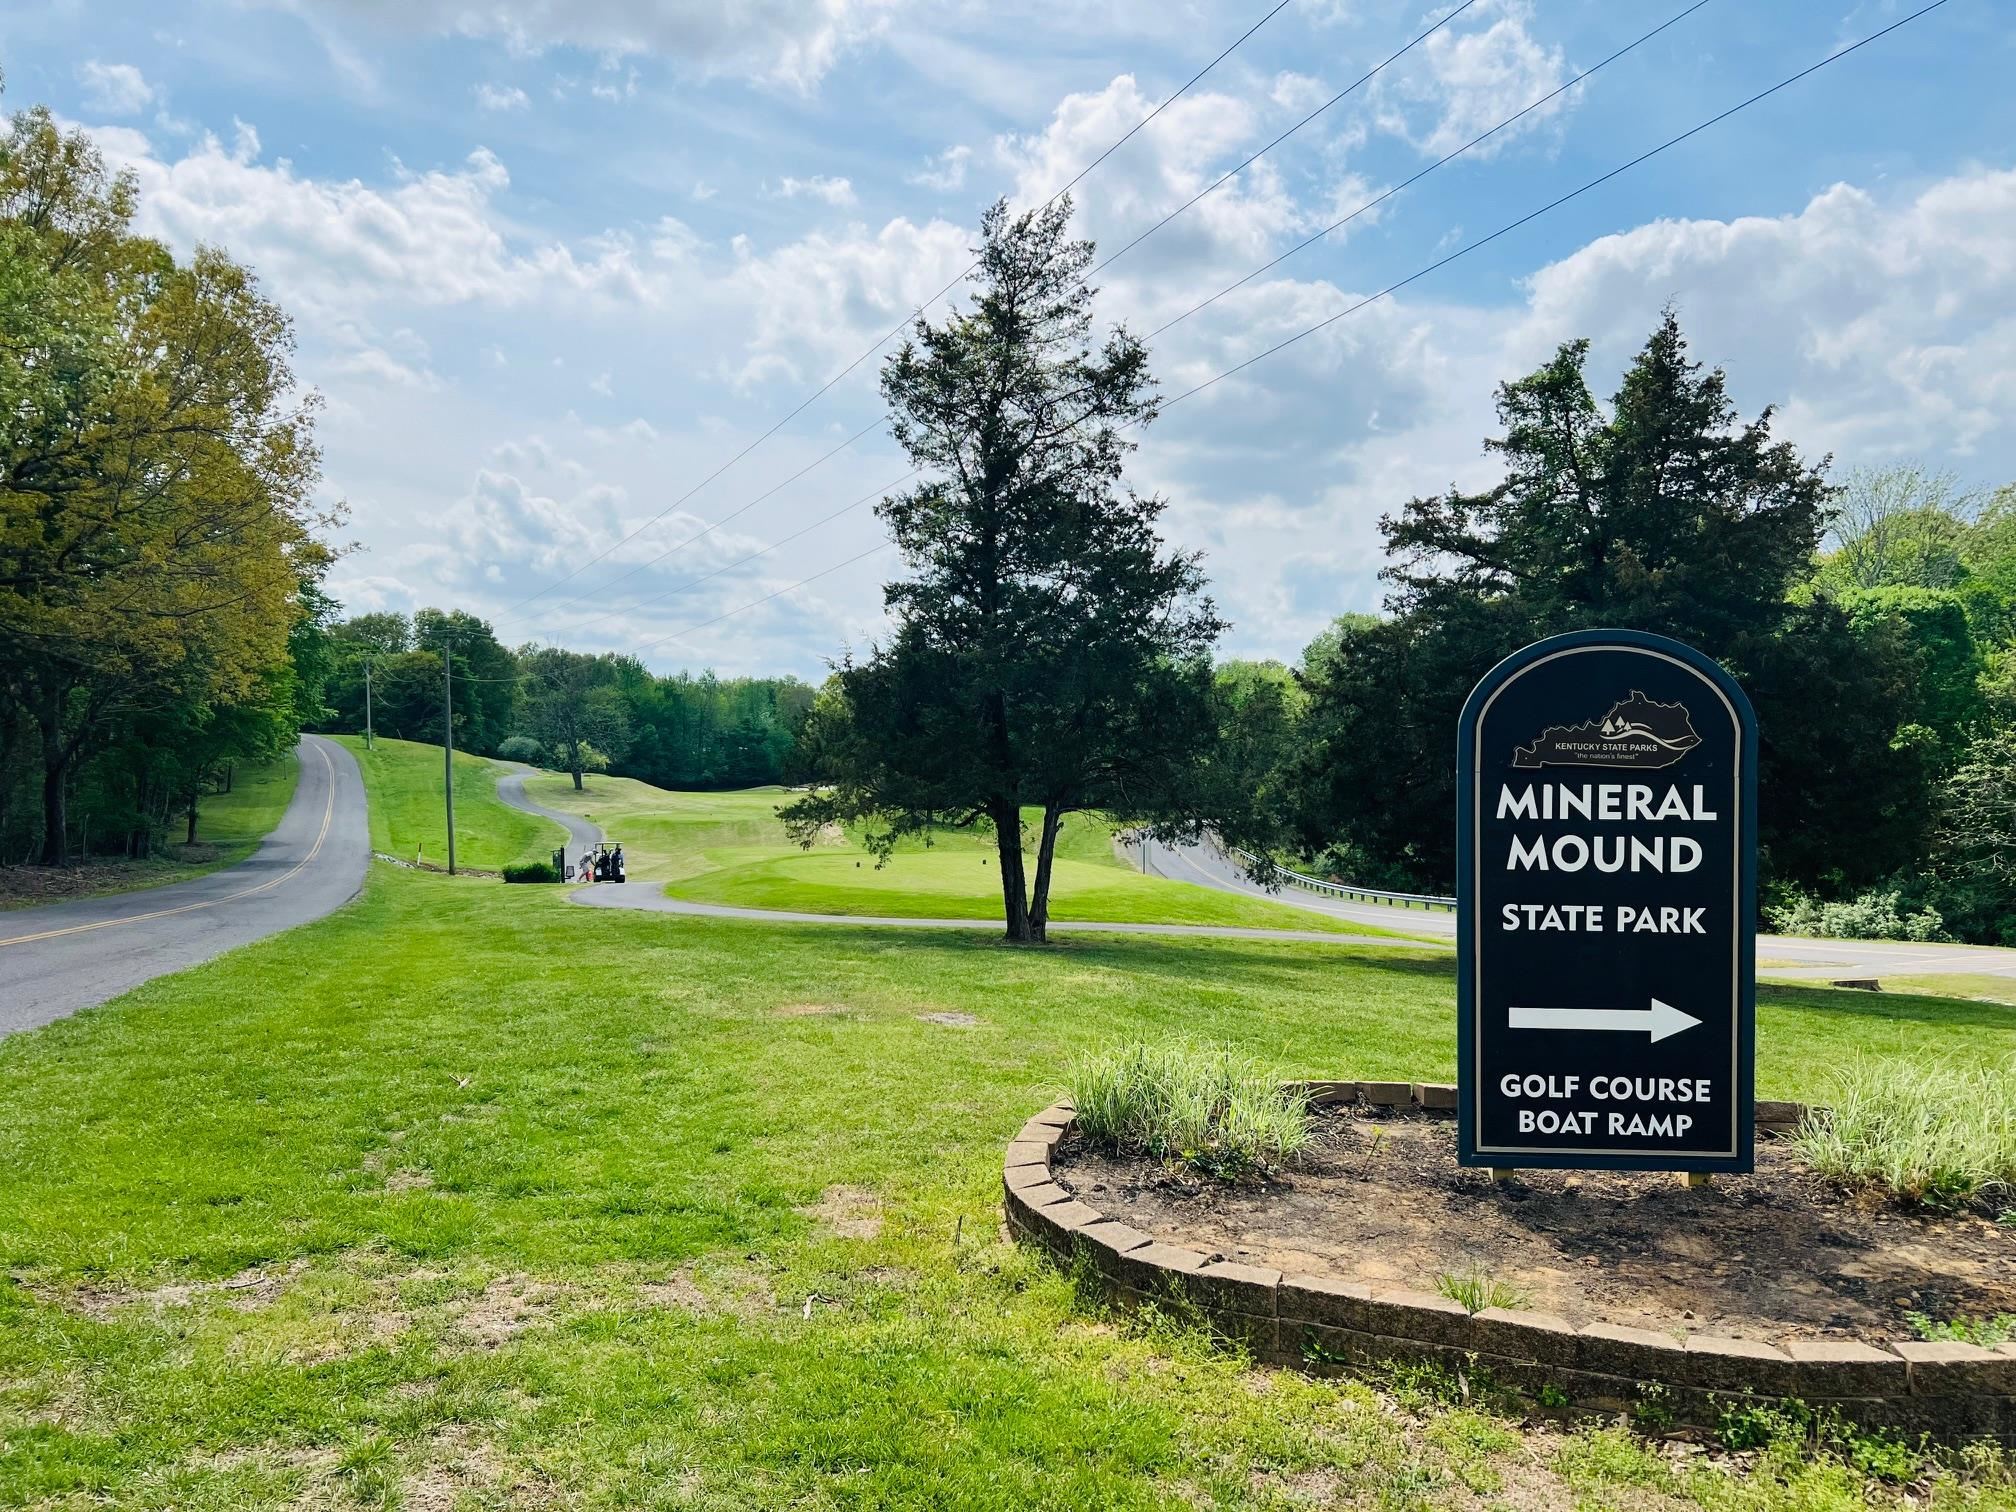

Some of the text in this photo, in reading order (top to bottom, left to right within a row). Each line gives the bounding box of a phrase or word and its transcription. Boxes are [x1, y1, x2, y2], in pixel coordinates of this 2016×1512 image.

[1555, 742, 1658, 752] KENTUCKY STATE PARKS
[1496, 783, 1718, 821] MINERAL
[1506, 833, 1703, 874] MOUND
[1502, 903, 1707, 934] STATE PARK
[1500, 1073, 1711, 1103] GOLF COURSE
[1519, 1110, 1693, 1138] BOAT RAMP
